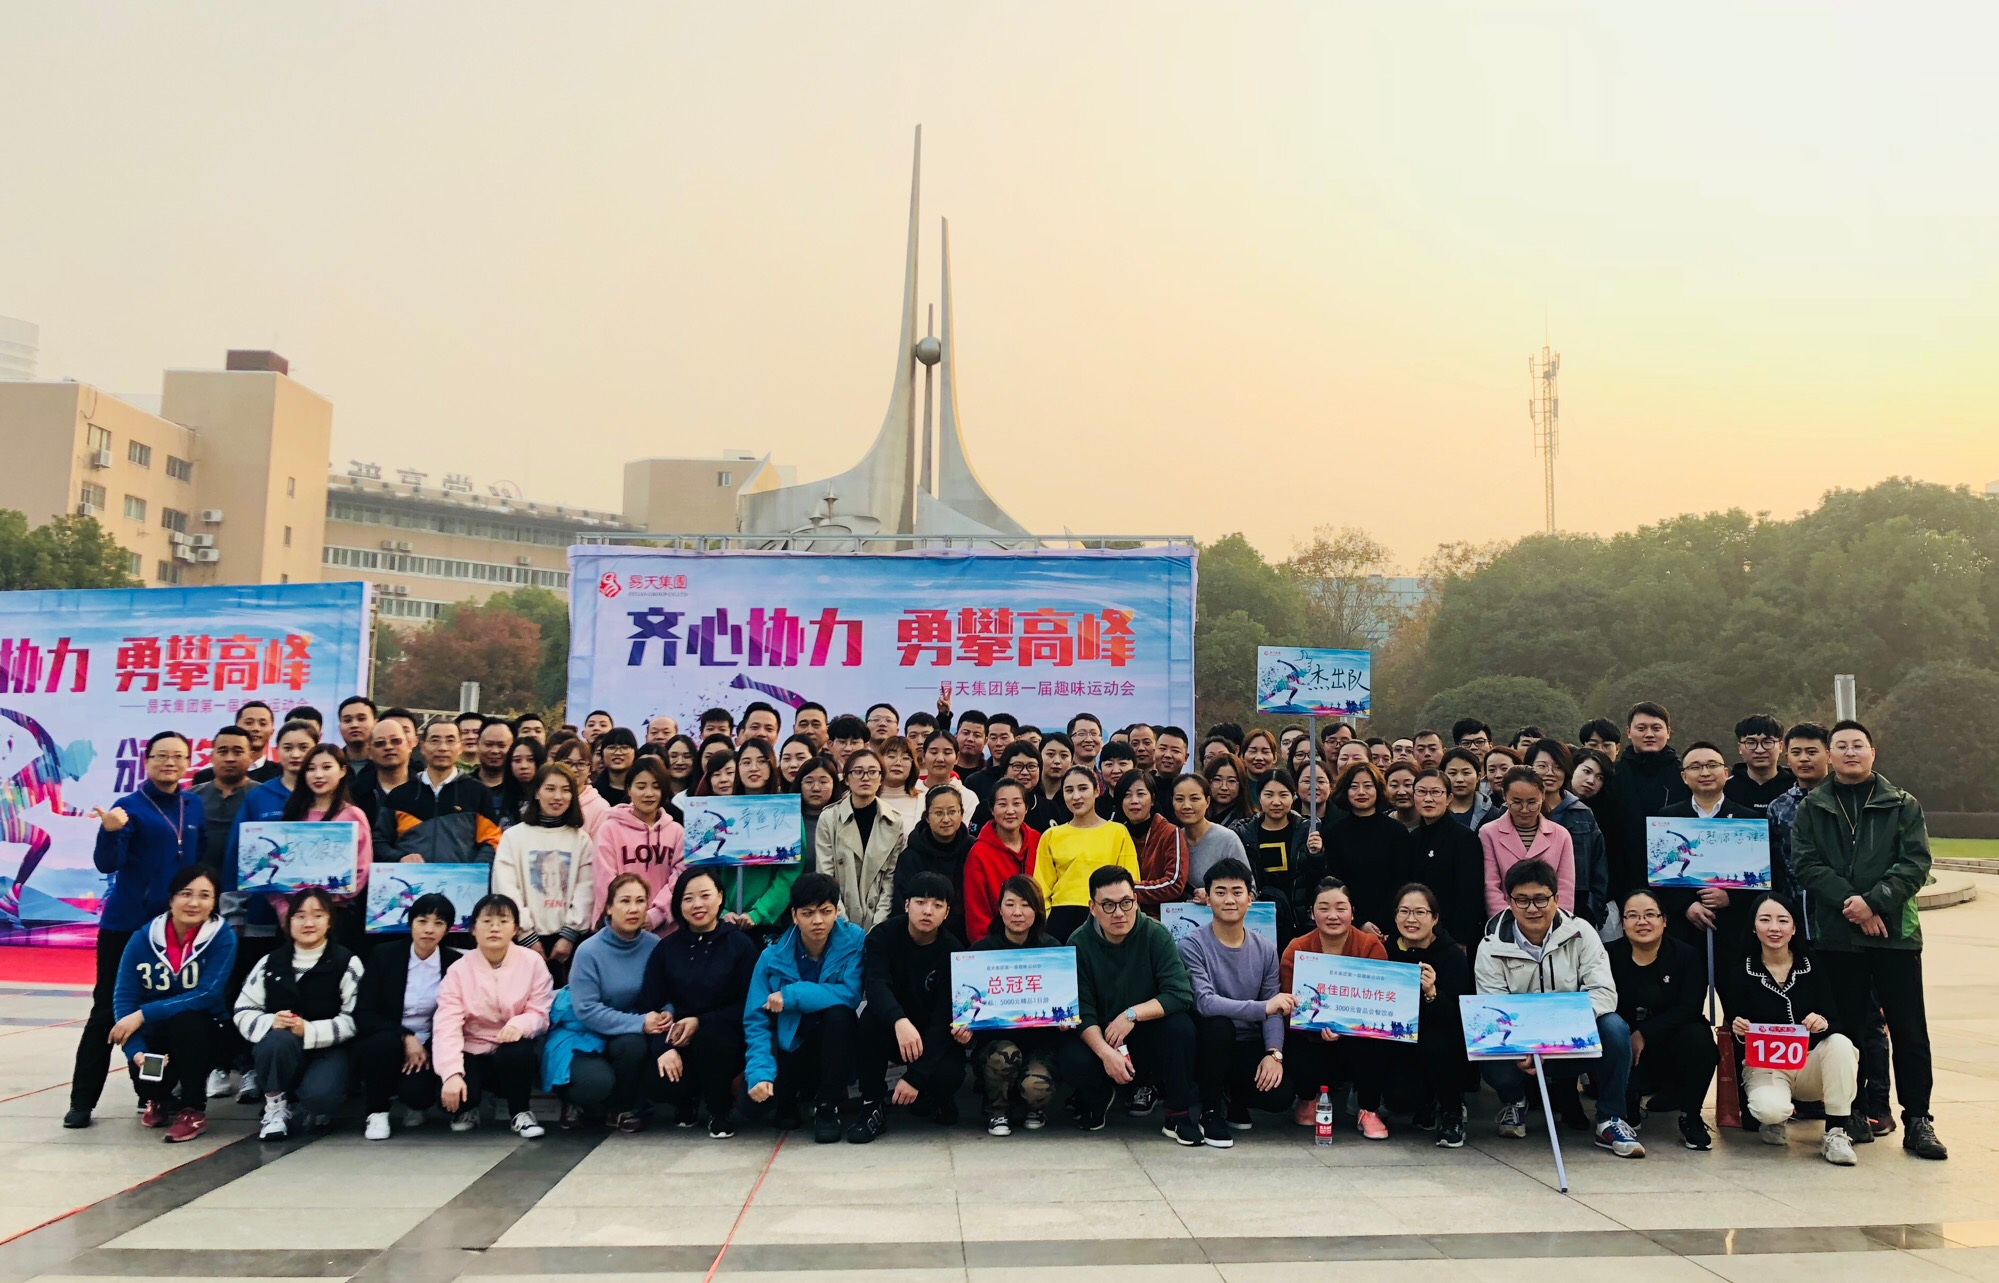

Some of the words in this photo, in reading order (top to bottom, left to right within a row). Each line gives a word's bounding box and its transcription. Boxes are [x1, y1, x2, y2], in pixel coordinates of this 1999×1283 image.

[627, 607, 863, 667] 齐心协力
[897, 608, 1136, 667] 勇攀高峰
[115, 634, 313, 692] 勇攀高峰
[1307, 663, 1370, 691] 杰出队
[136, 961, 199, 991] 330
[987, 974, 1043, 994] 总冠军
[1316, 982, 1397, 1003] 最佳团队协作奖
[1752, 1039, 1804, 1064] 120
